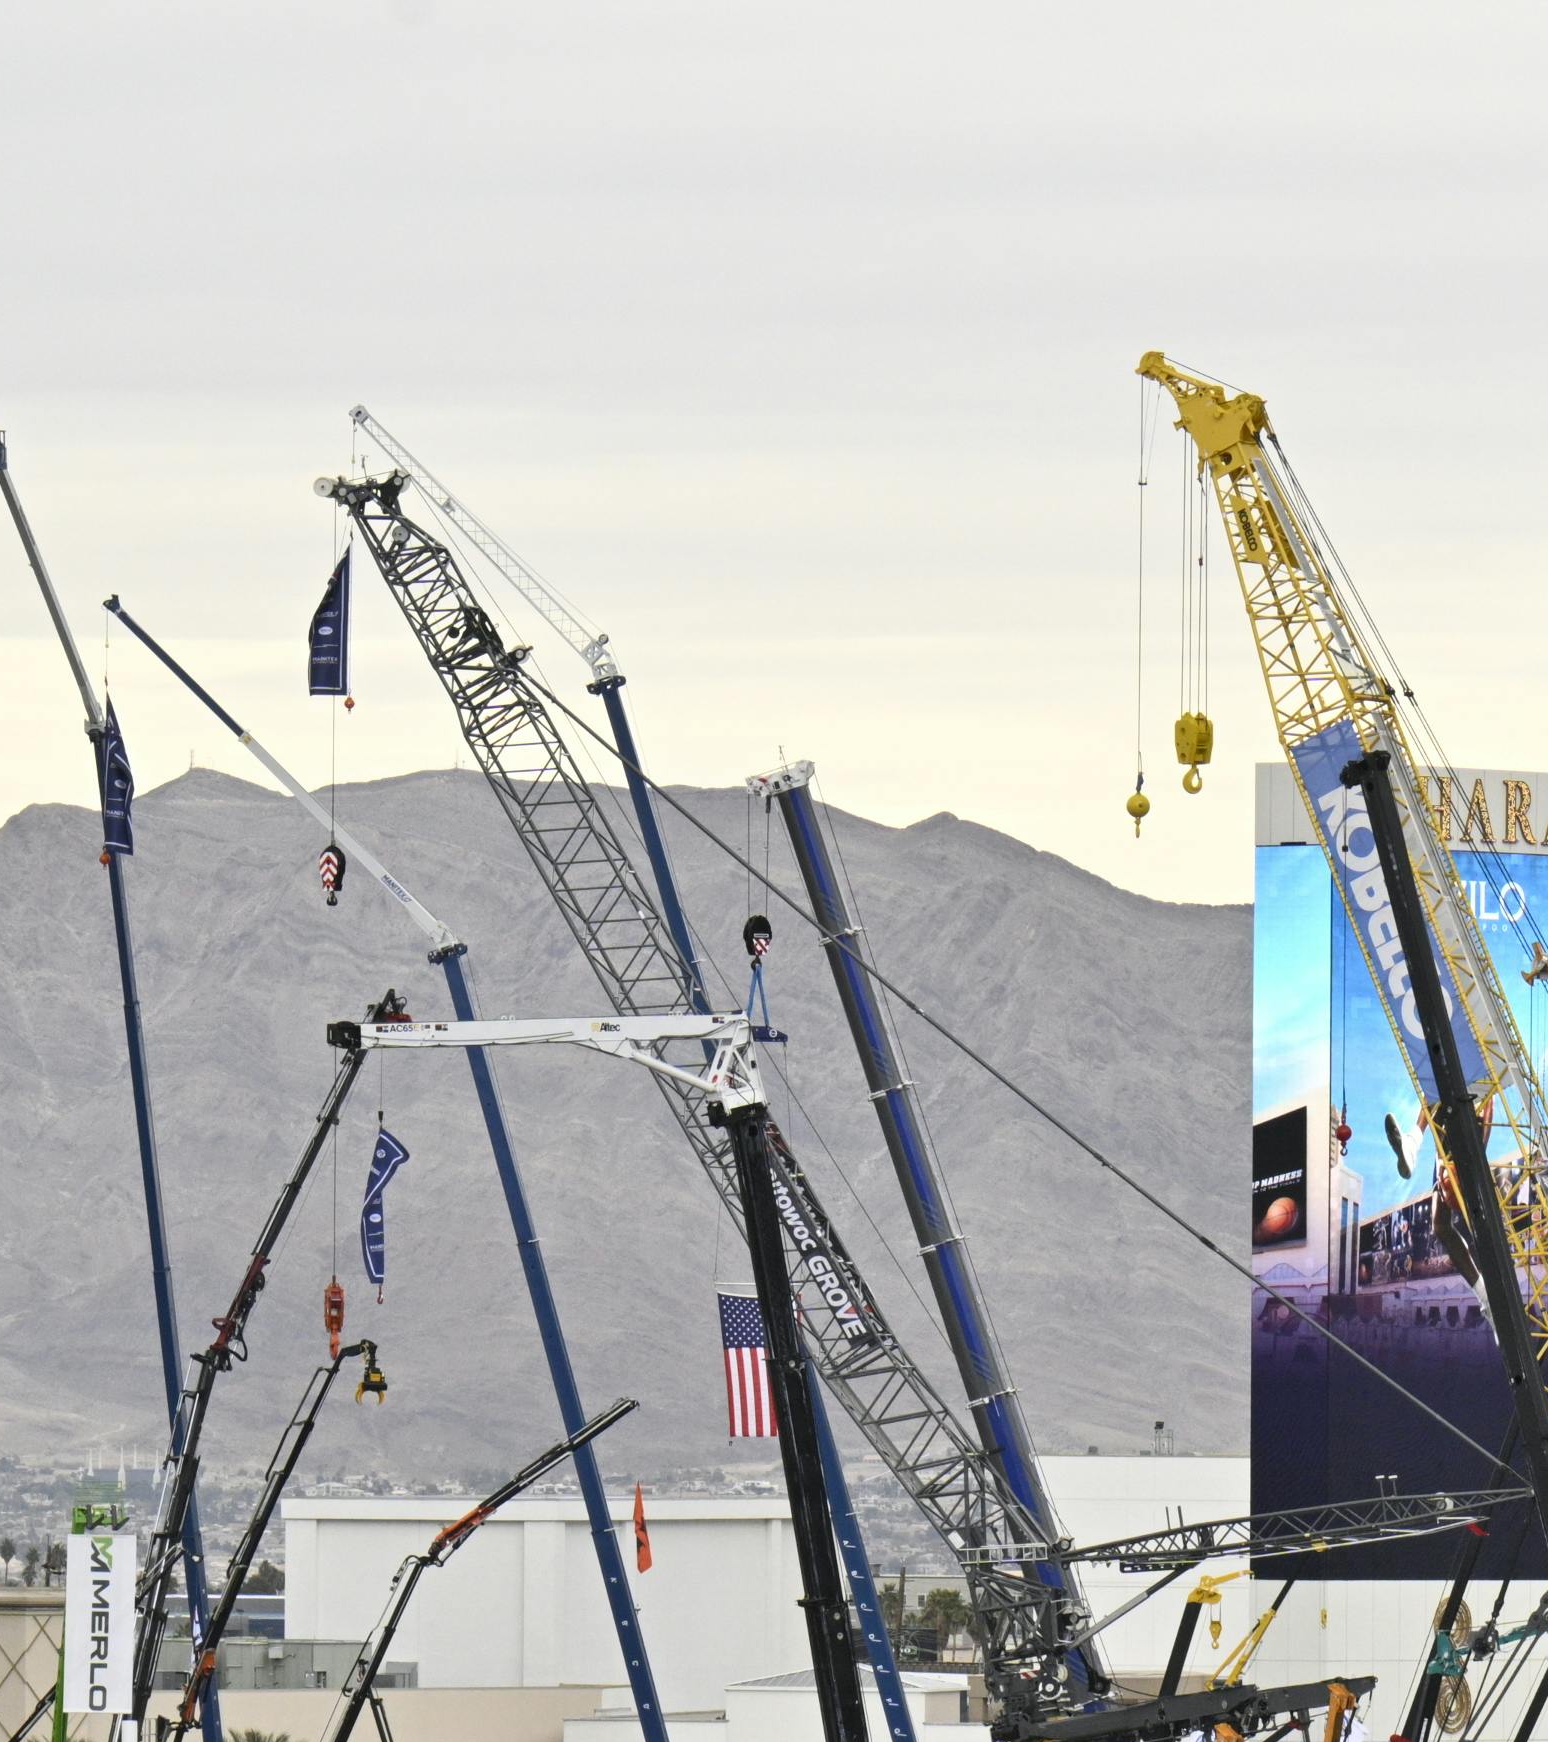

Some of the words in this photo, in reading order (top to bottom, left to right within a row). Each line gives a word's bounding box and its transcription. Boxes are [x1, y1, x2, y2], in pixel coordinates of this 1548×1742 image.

[1318, 782, 1454, 1041] KOBELCO
[598, 1022, 620, 1032] Altec
[89, 1579, 110, 1712] MERLO
